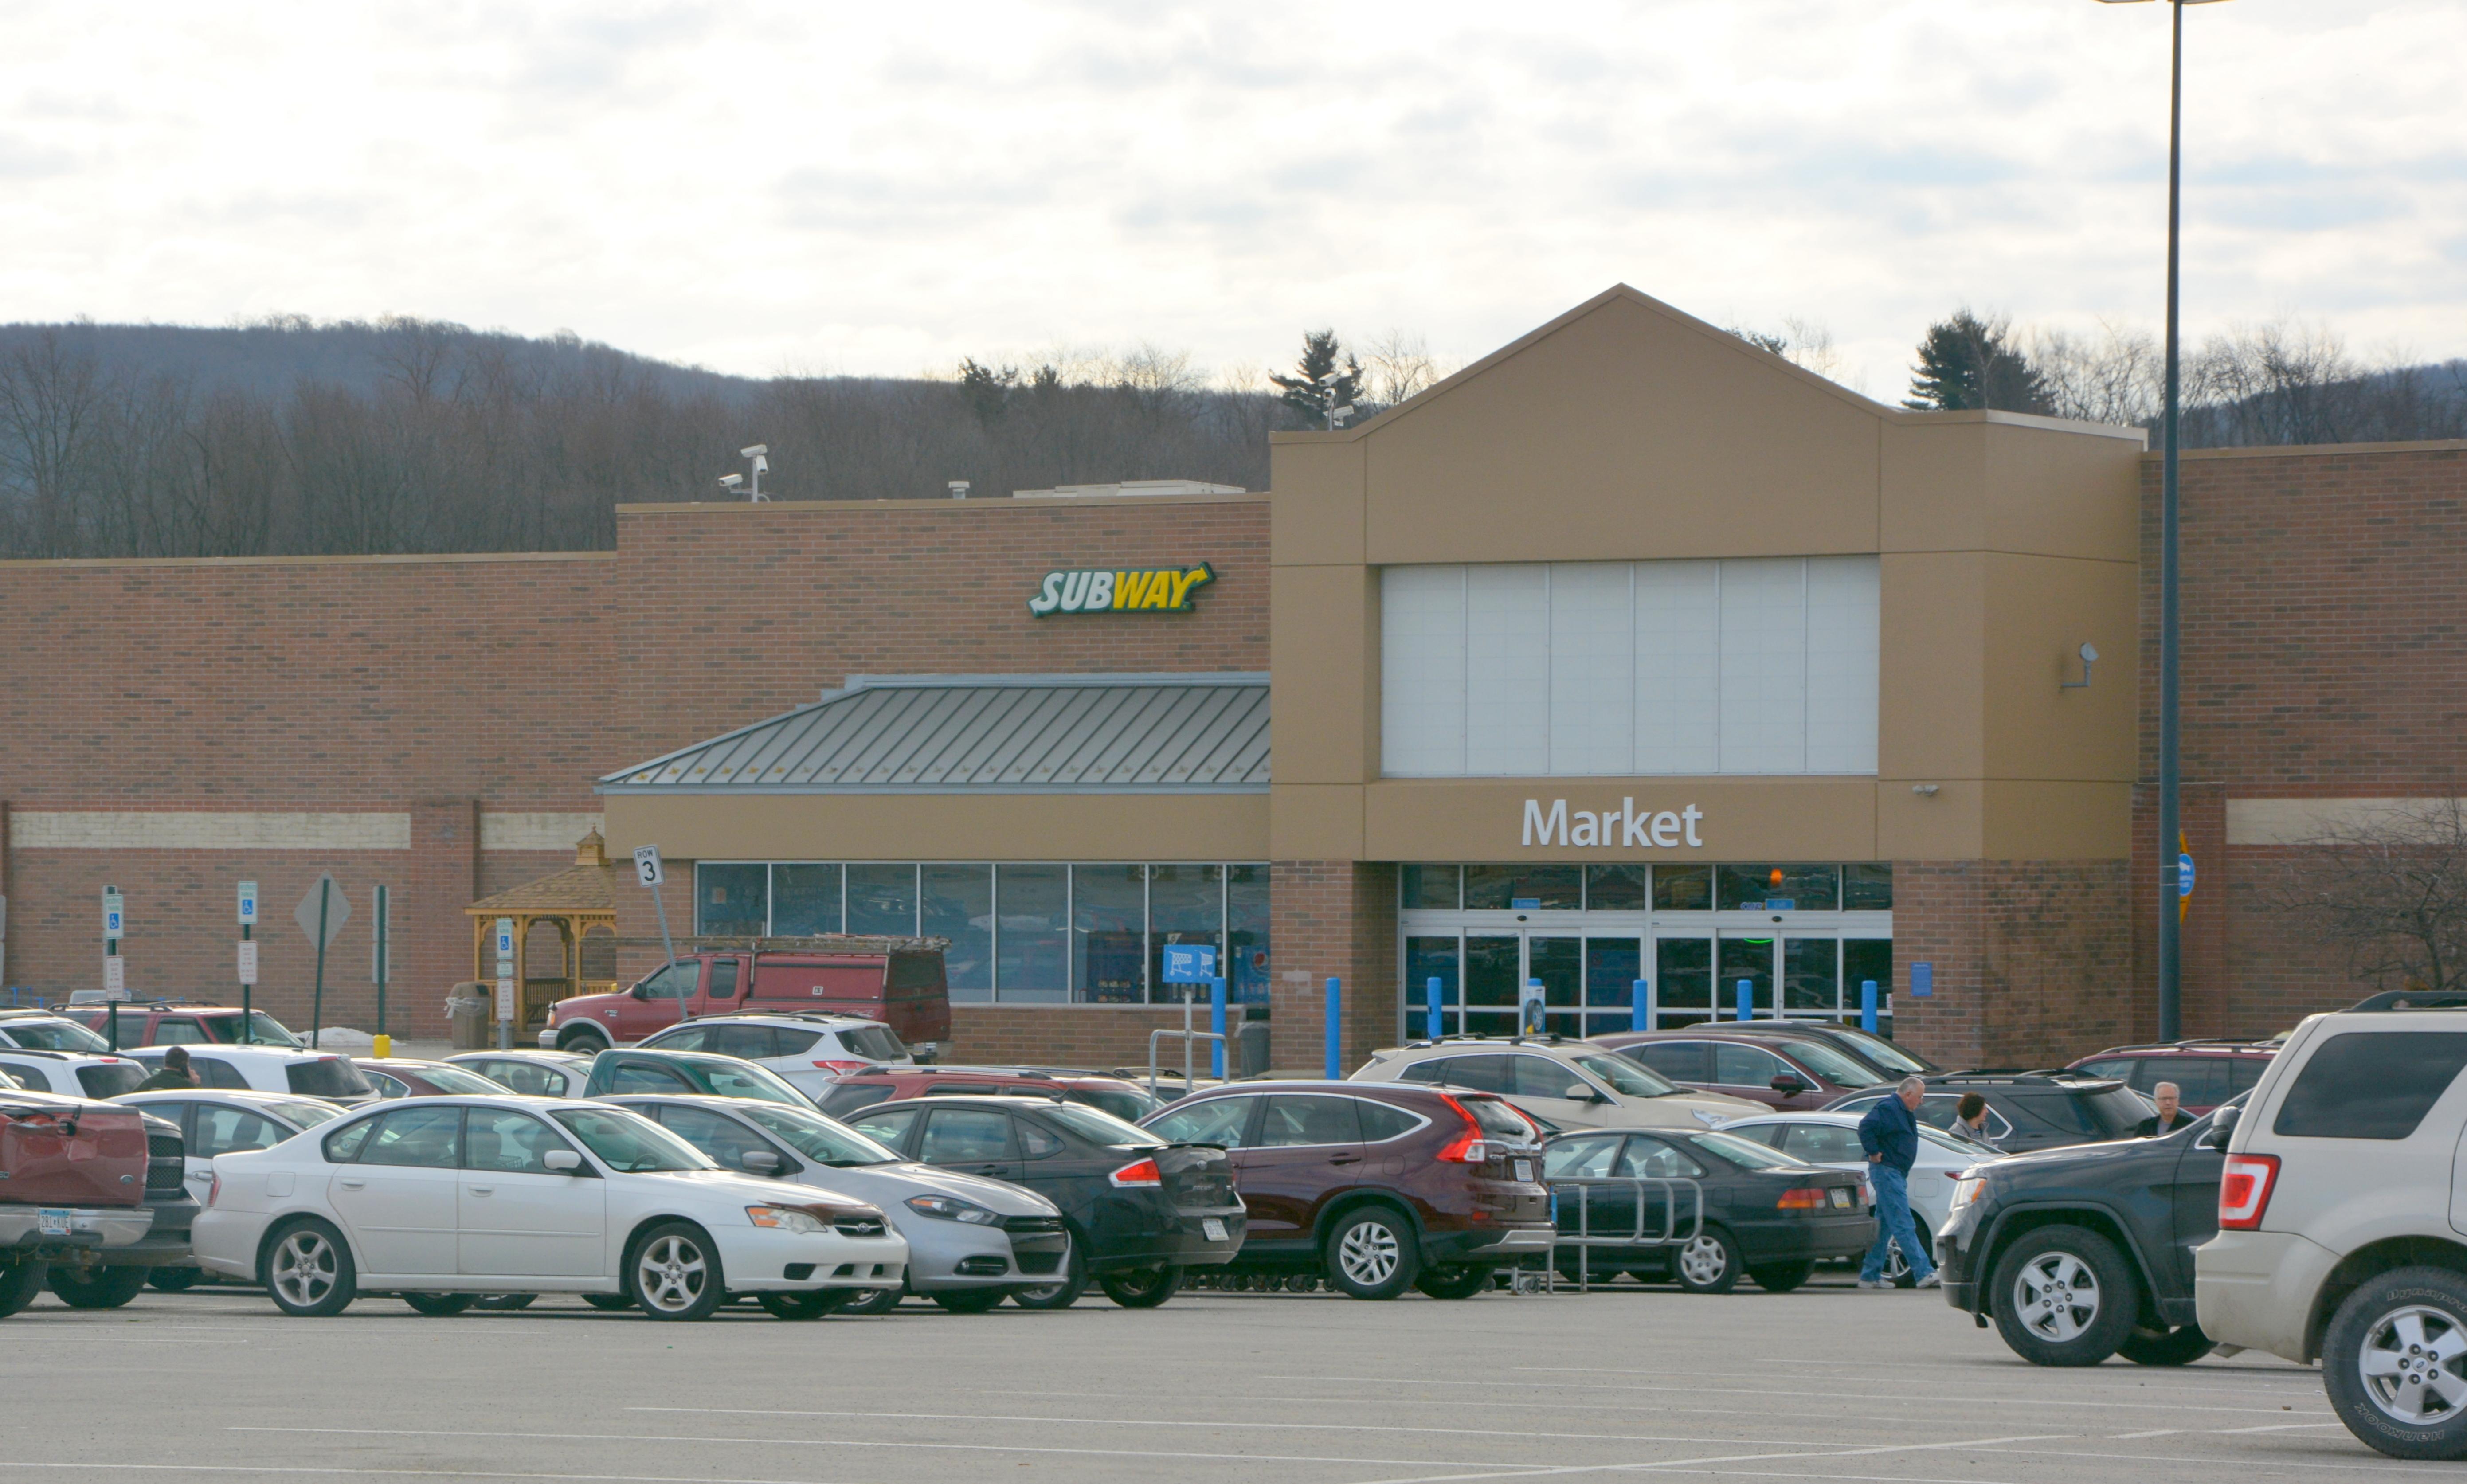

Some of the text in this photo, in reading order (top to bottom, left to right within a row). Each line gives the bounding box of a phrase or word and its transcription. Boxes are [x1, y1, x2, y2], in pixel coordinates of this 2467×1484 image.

[1029, 567, 1208, 611] SUBWAY
[1522, 797, 1703, 847] Market
[637, 849, 653, 858] ROW
[642, 861, 656, 881] 3
